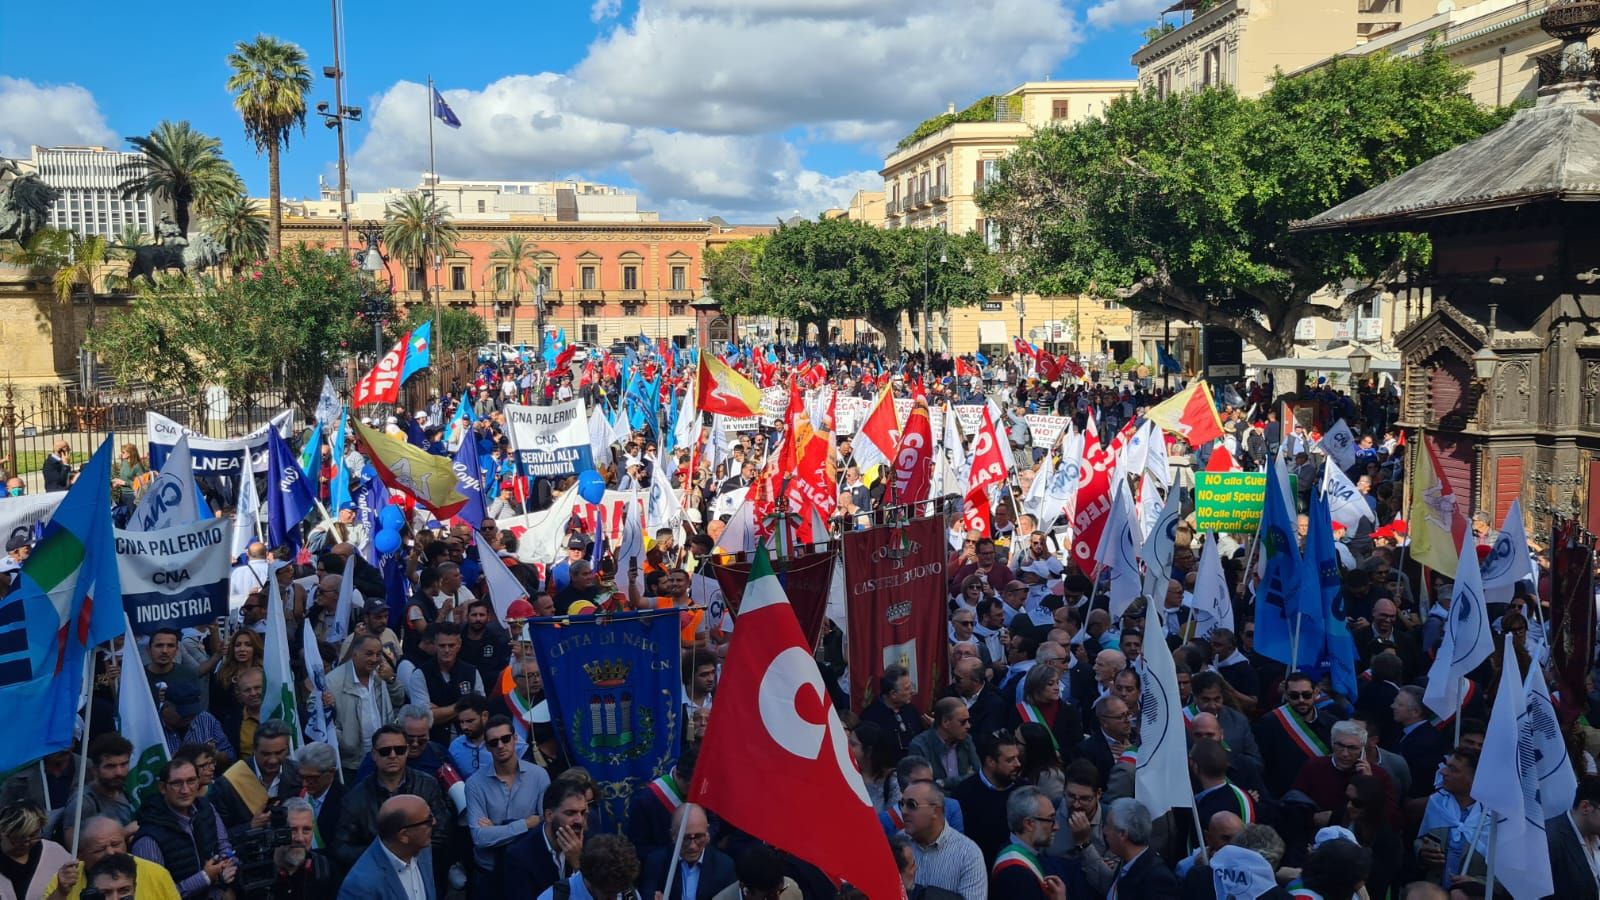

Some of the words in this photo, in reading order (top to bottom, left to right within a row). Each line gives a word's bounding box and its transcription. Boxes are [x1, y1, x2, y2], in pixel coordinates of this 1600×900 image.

[512, 410, 533, 425] CNA
[535, 407, 578, 425] PALERMO
[155, 423, 177, 435] CNA
[535, 434, 559, 446] CNA
[521, 451, 556, 463] SERVIZI
[557, 448, 580, 462] ALLA
[1205, 474, 1221, 485] NO
[1223, 476, 1242, 485] alla
[1244, 475, 1266, 486] Guer
[1198, 490, 1213, 500] NO
[1214, 491, 1232, 503] agli
[1233, 491, 1265, 503] Specul
[1327, 478, 1354, 501] CNA
[1198, 507, 1213, 517] NO
[1213, 510, 1230, 518] alle
[1231, 508, 1264, 520] Ingiust
[1199, 520, 1241, 531] confronti
[115, 537, 147, 556] CNA
[149, 527, 223, 557] PALERMO
[893, 559, 904, 570] DI
[152, 568, 191, 586] CNA
[854, 561, 942, 596] CASTELBUONO
[136, 597, 213, 624] INDUSTRIA
[600, 631, 615, 645] DI
[1214, 868, 1248, 886] CNA
